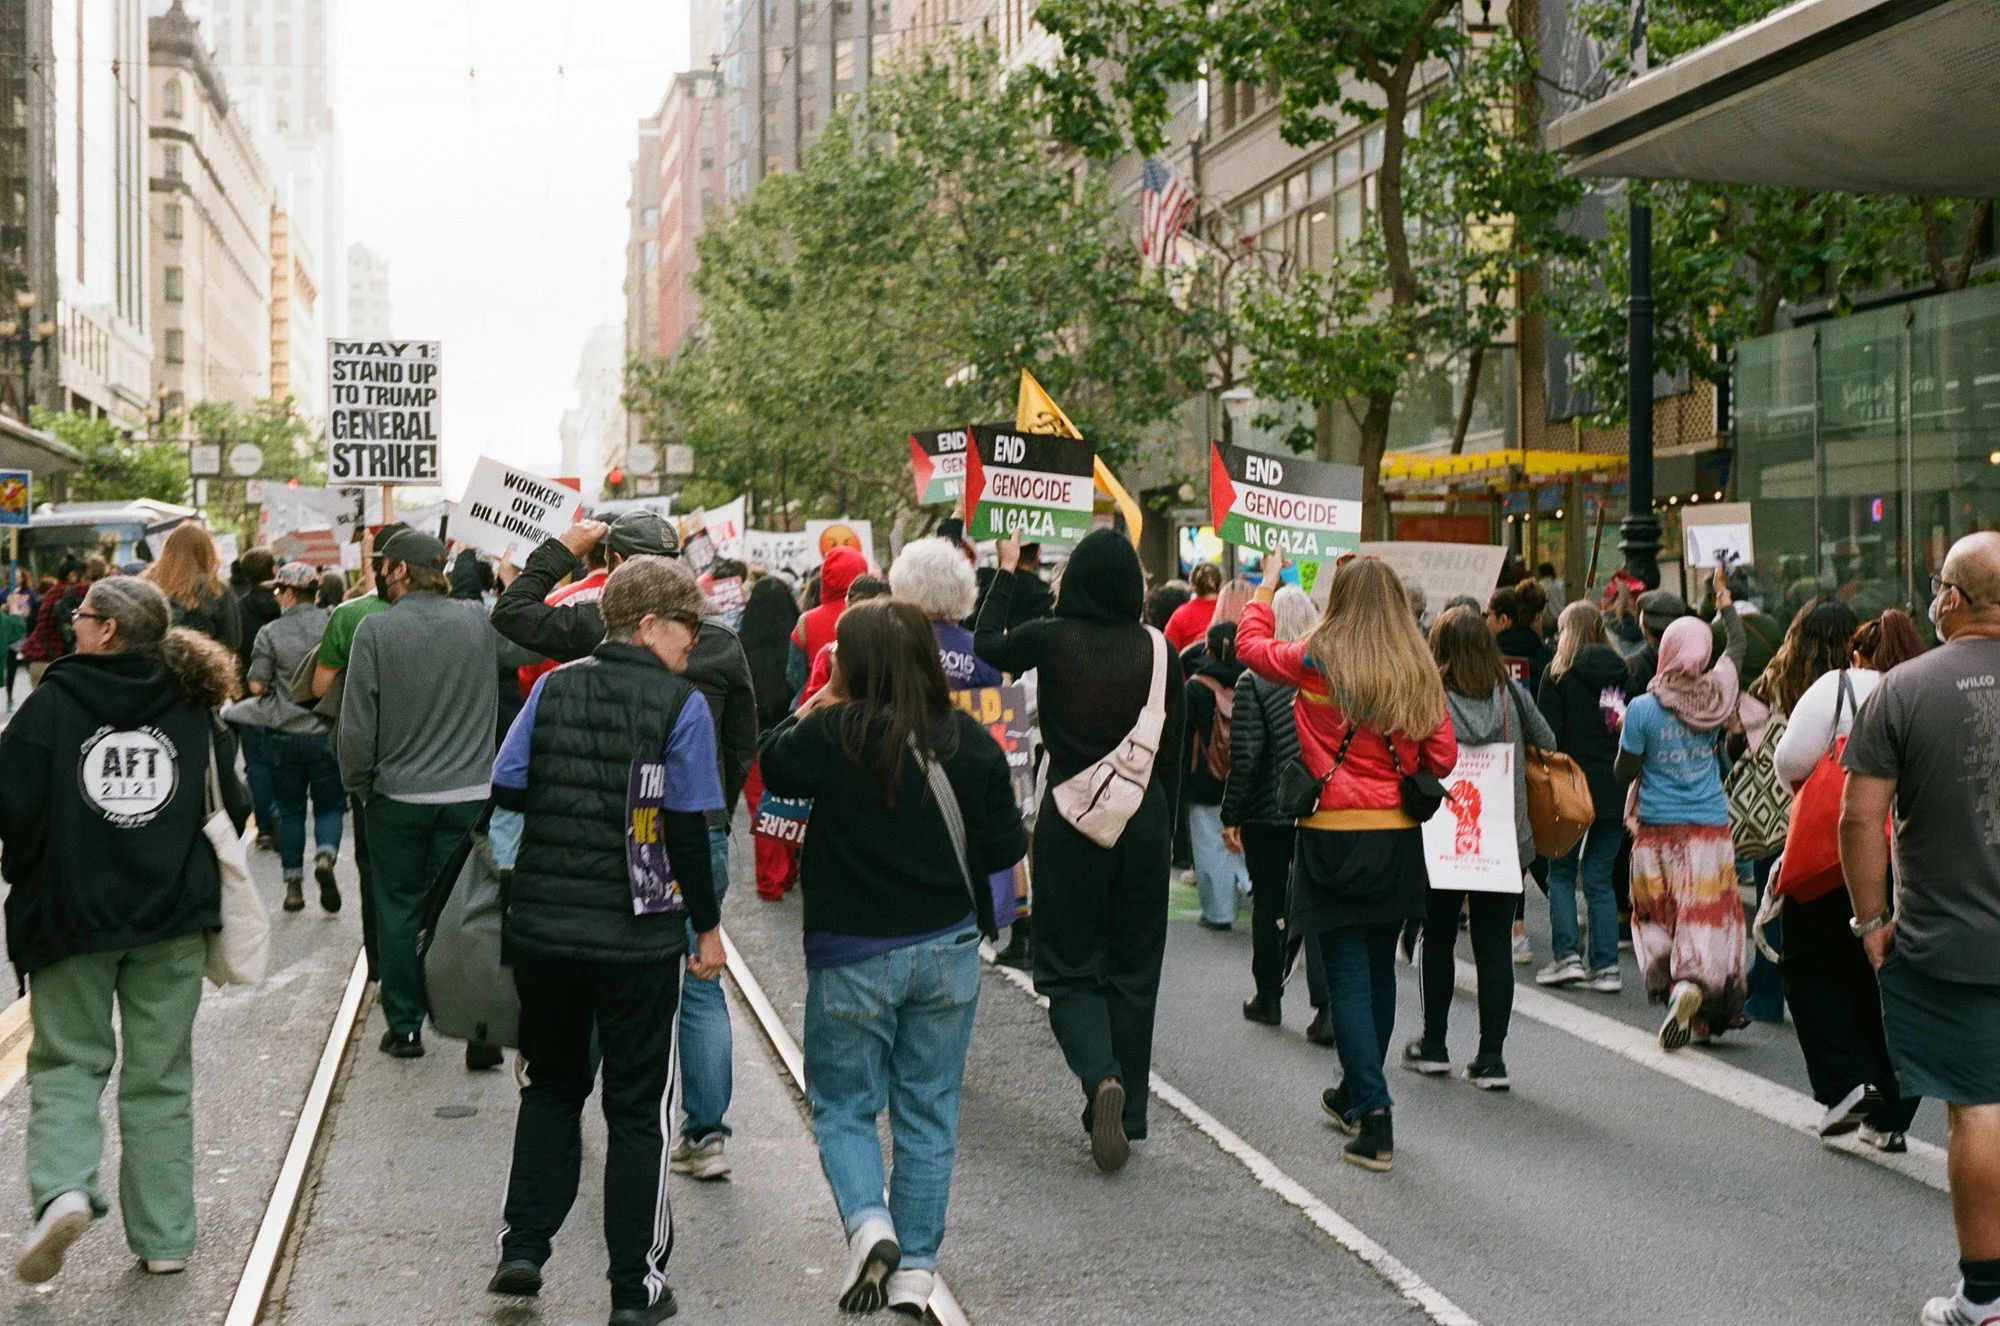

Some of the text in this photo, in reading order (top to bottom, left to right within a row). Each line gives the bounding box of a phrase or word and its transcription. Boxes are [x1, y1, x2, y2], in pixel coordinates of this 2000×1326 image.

[334, 342, 409, 358] MAY
[333, 360, 437, 384] STAND UP
[333, 384, 437, 407] TO TRUMP
[332, 410, 437, 440] GENERAL
[937, 431, 967, 452] END
[994, 434, 1026, 464] END
[333, 443, 437, 478] STRIKE!
[1245, 455, 1283, 486] END
[503, 471, 565, 509] WORKERS
[992, 473, 1072, 503] GENOCIDE
[511, 497, 546, 523] OVER
[990, 507, 1004, 534] IN
[1006, 508, 1056, 537] GAZA
[1245, 490, 1338, 525] GENOCIDE
[1244, 521, 1319, 555] IN GAZA
[1956, 674, 1995, 690] WILCO
[101, 746, 159, 778] AFT
[101, 781, 156, 796] 2121
